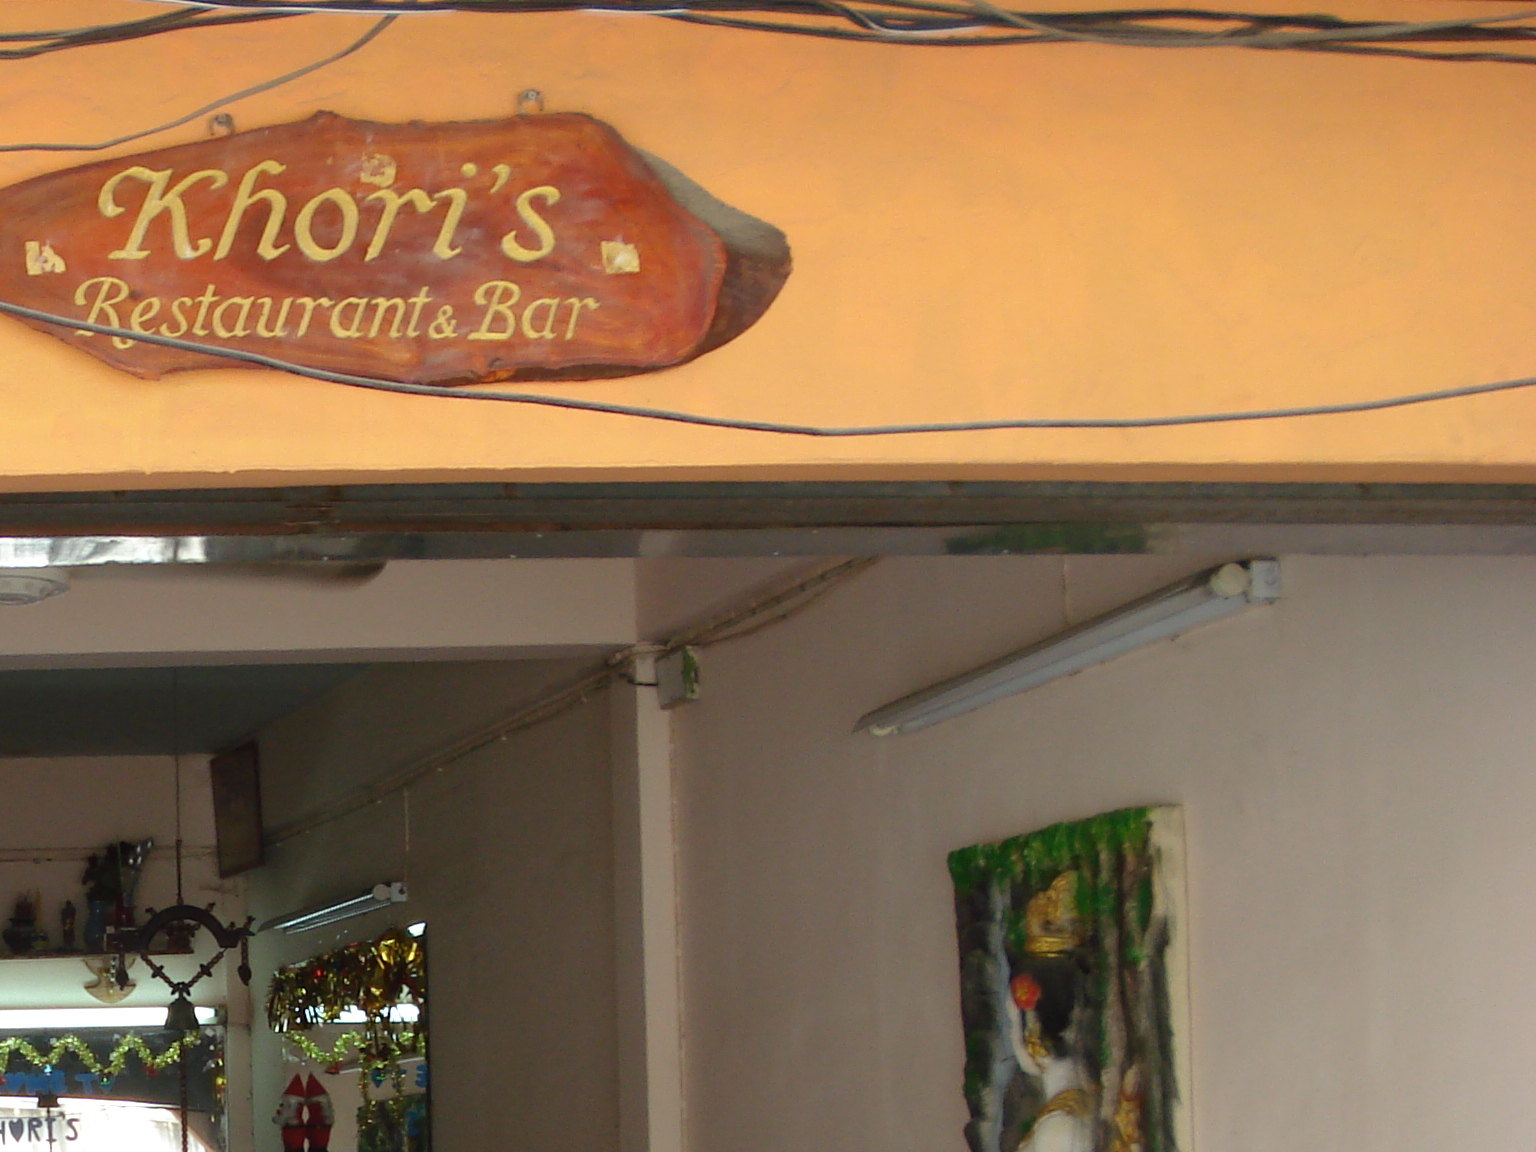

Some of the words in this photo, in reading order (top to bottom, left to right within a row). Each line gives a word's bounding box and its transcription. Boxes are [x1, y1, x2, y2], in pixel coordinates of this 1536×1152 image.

[98, 159, 560, 262] Khori's
[74, 276, 436, 349] Restaurant
[429, 304, 457, 338] &
[468, 280, 600, 341] Bar
